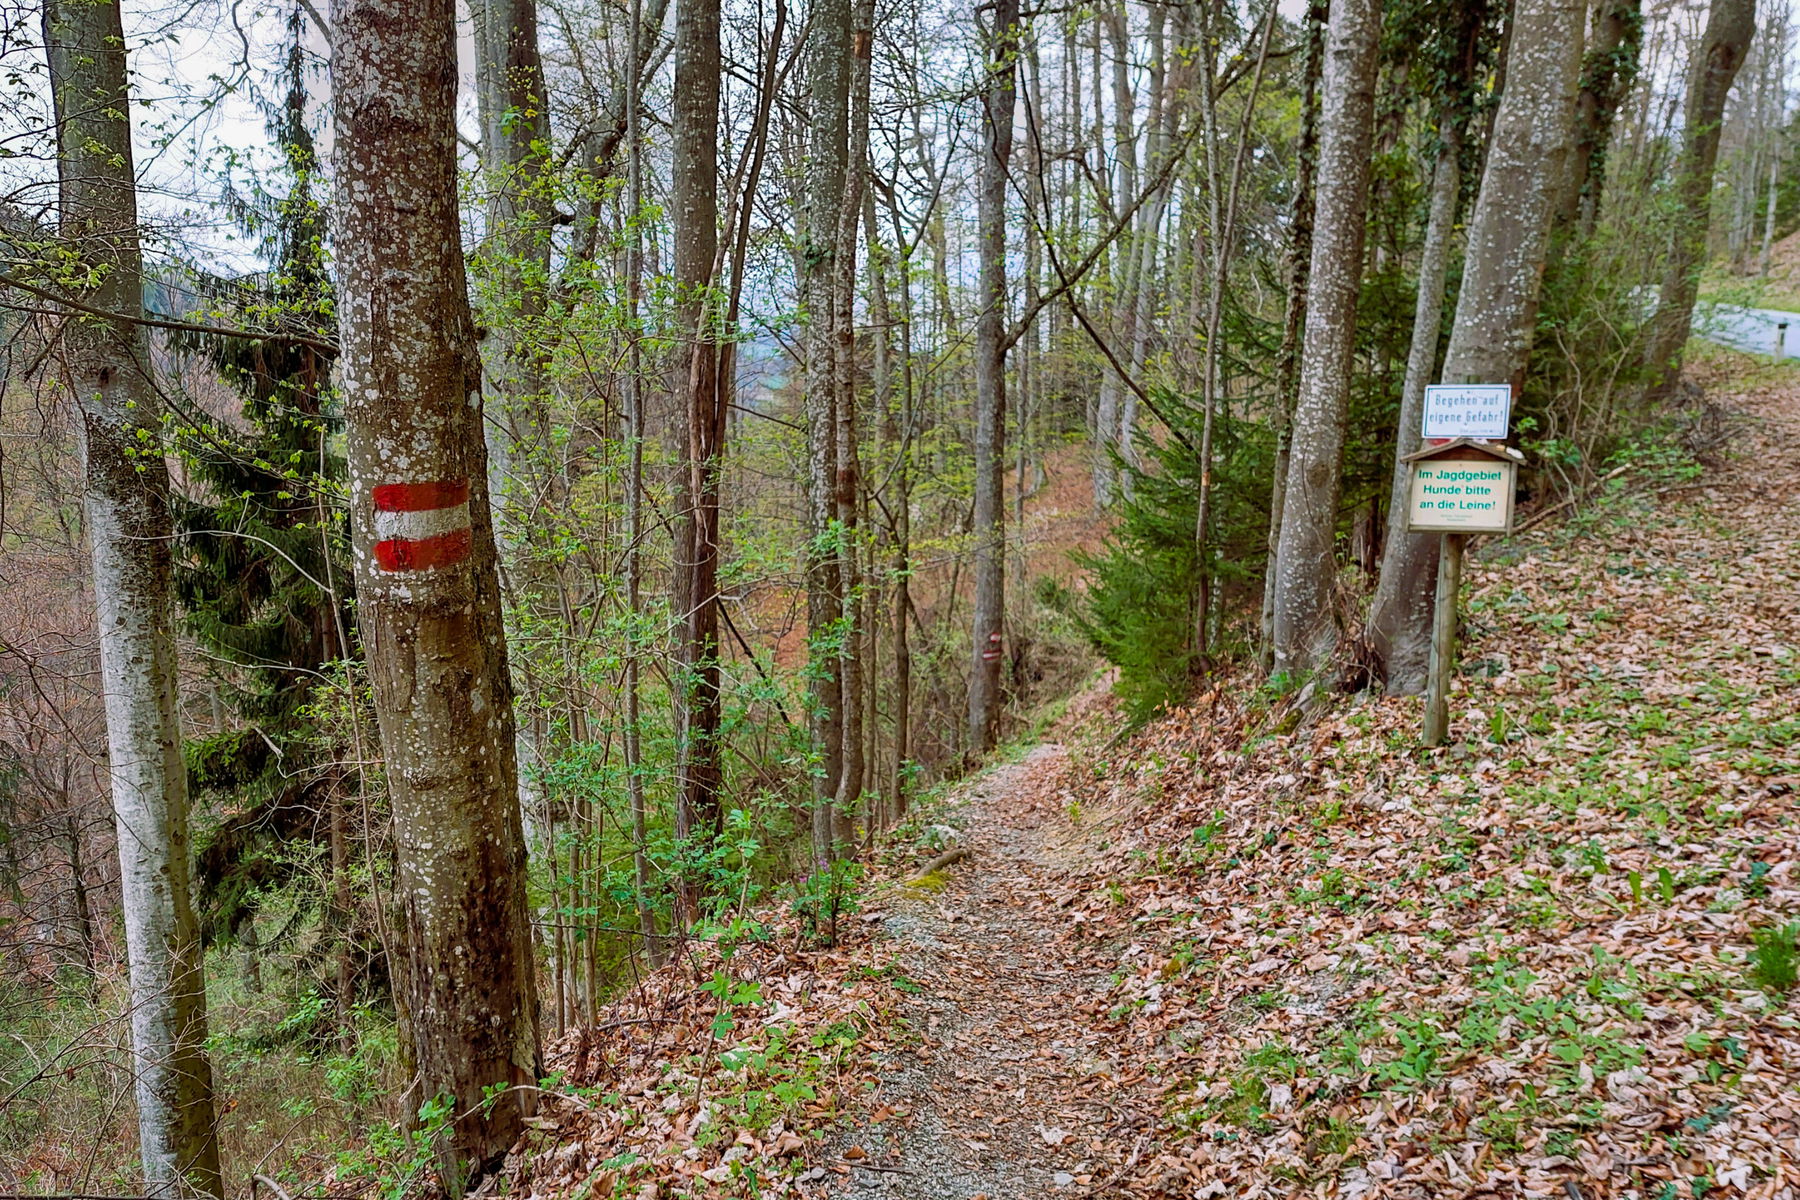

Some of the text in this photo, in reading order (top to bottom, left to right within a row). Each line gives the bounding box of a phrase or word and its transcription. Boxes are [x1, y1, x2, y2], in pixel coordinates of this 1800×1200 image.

[1435, 394, 1499, 407] Begehen auf
[1430, 411, 1503, 424] eigene Gefahr!
[1419, 470, 1502, 482] Im Jagdgebiet
[1423, 485, 1491, 495] Hunde bitte
[1438, 500, 1455, 509] die
[1460, 501, 1495, 510] Leine!
